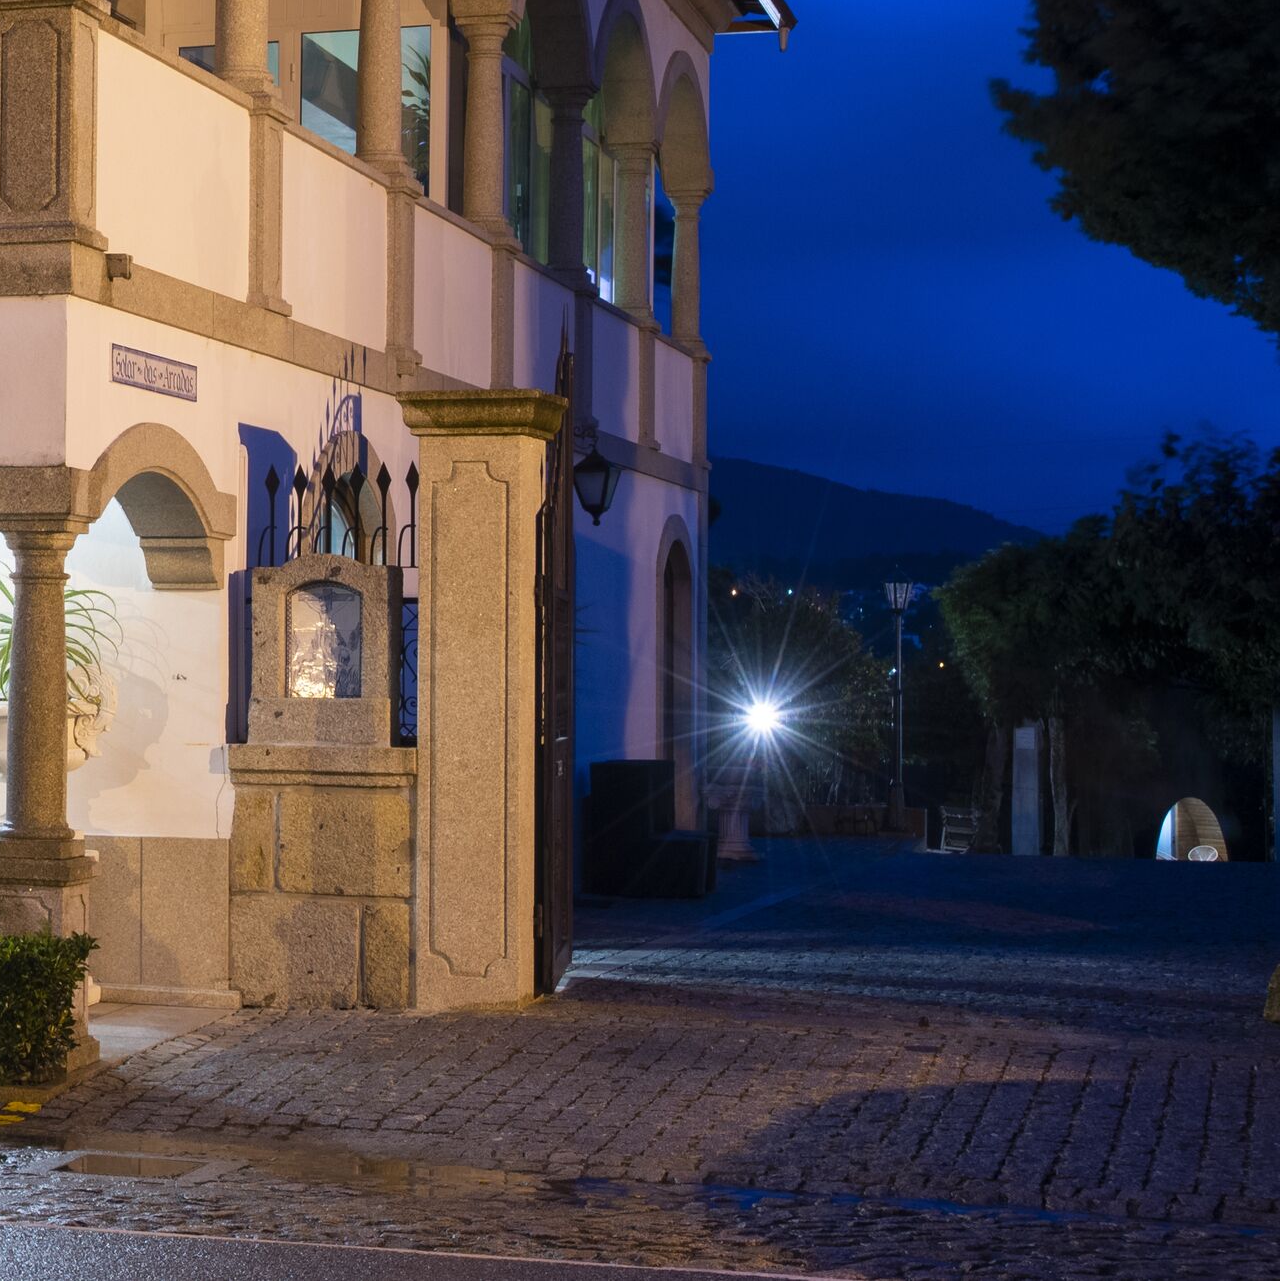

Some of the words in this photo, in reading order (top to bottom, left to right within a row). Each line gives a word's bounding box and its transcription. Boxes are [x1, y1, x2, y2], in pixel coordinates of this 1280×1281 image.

[116, 353, 137, 380] Solar
[143, 359, 157, 385] das
[162, 365, 194, 394] Arcadas
